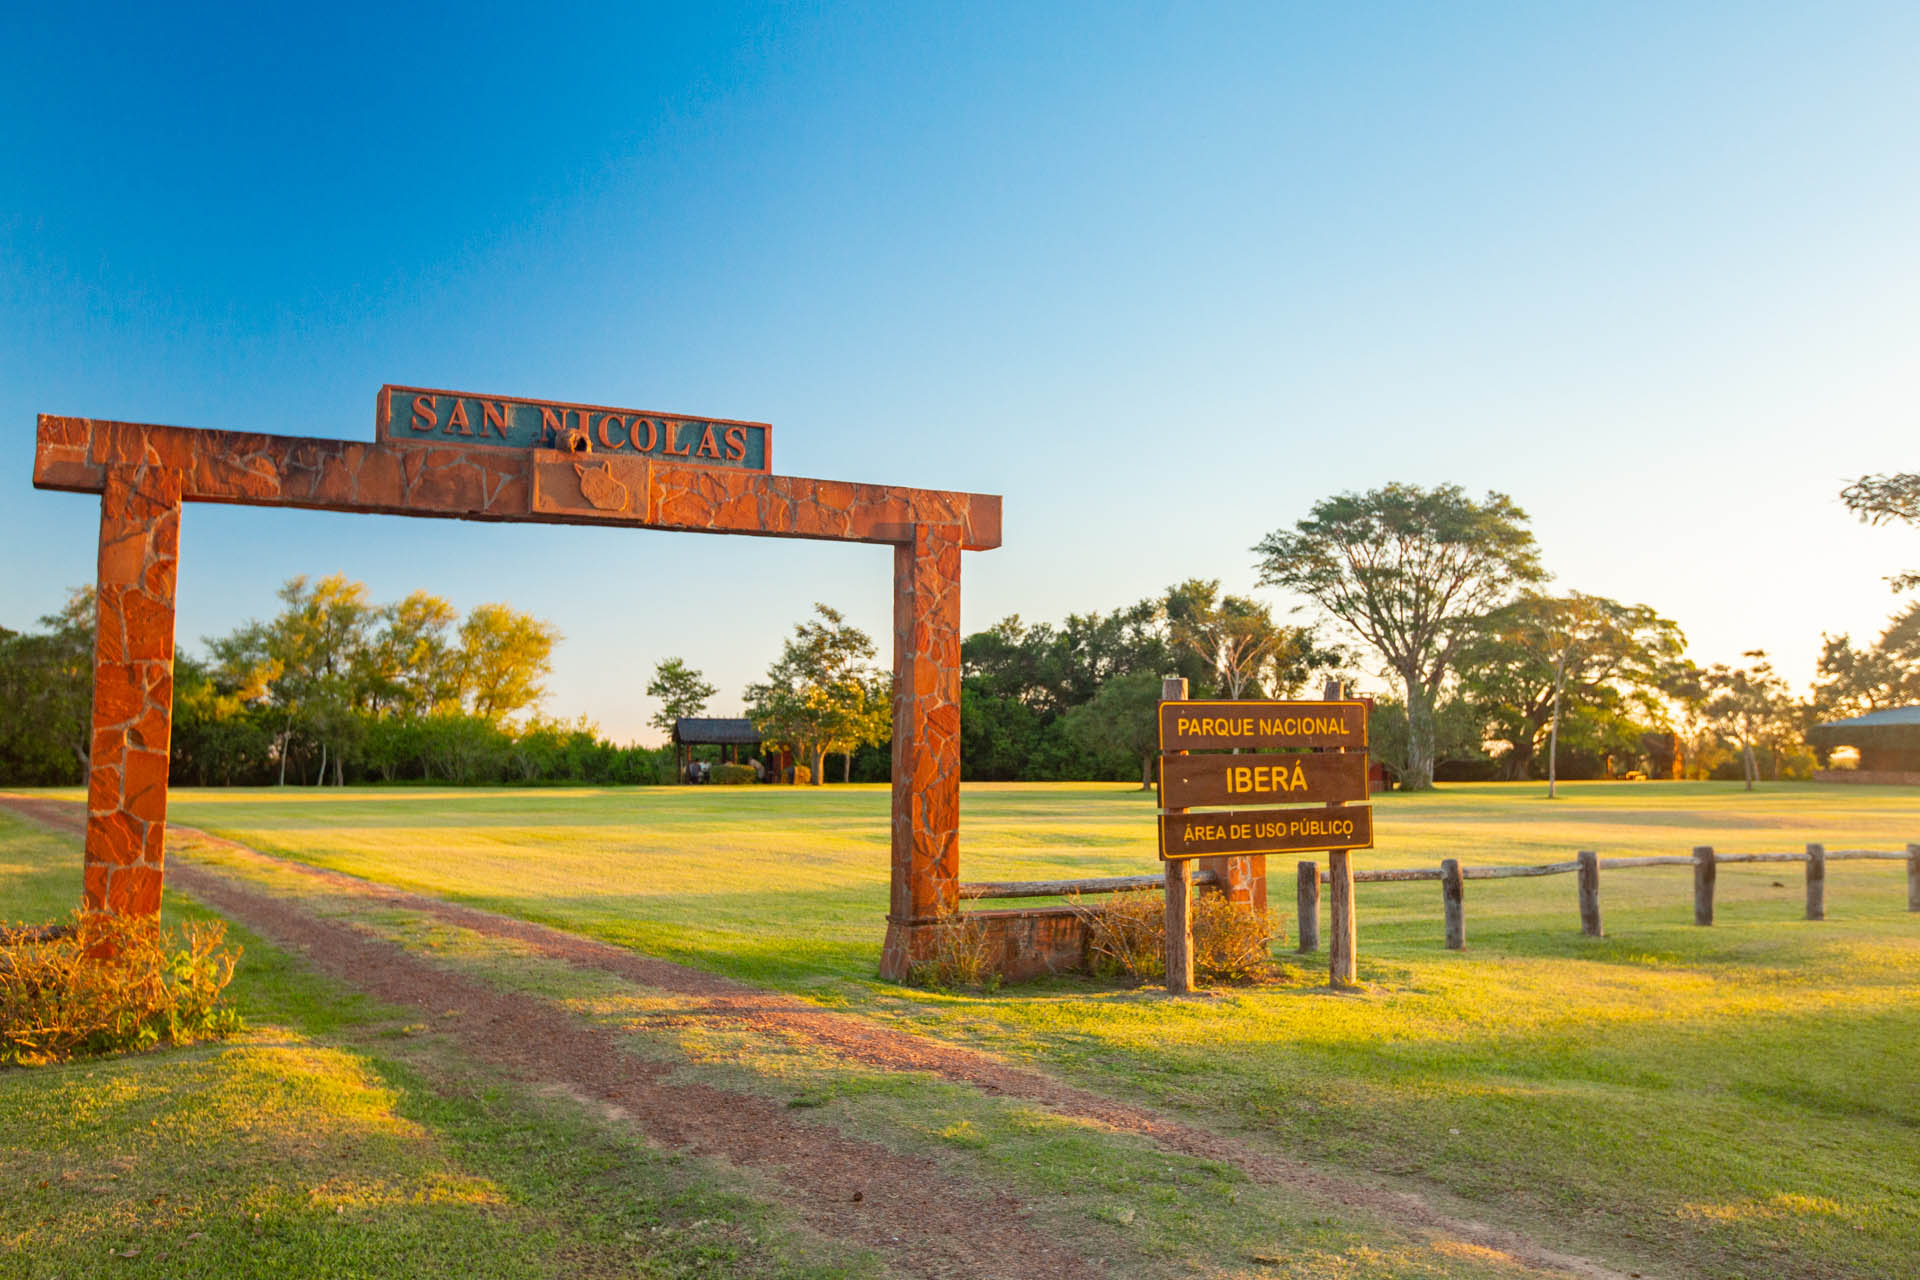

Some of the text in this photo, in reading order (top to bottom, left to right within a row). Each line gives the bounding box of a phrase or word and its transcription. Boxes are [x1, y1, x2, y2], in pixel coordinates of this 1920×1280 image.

[411, 394, 747, 461] SAN NICOLAS
[1177, 717, 1350, 737] PARQUE NACIONAL
[1226, 759, 1309, 793] IBERÁ
[1183, 818, 1354, 842] ÁREA DE USO PÚBLICO
